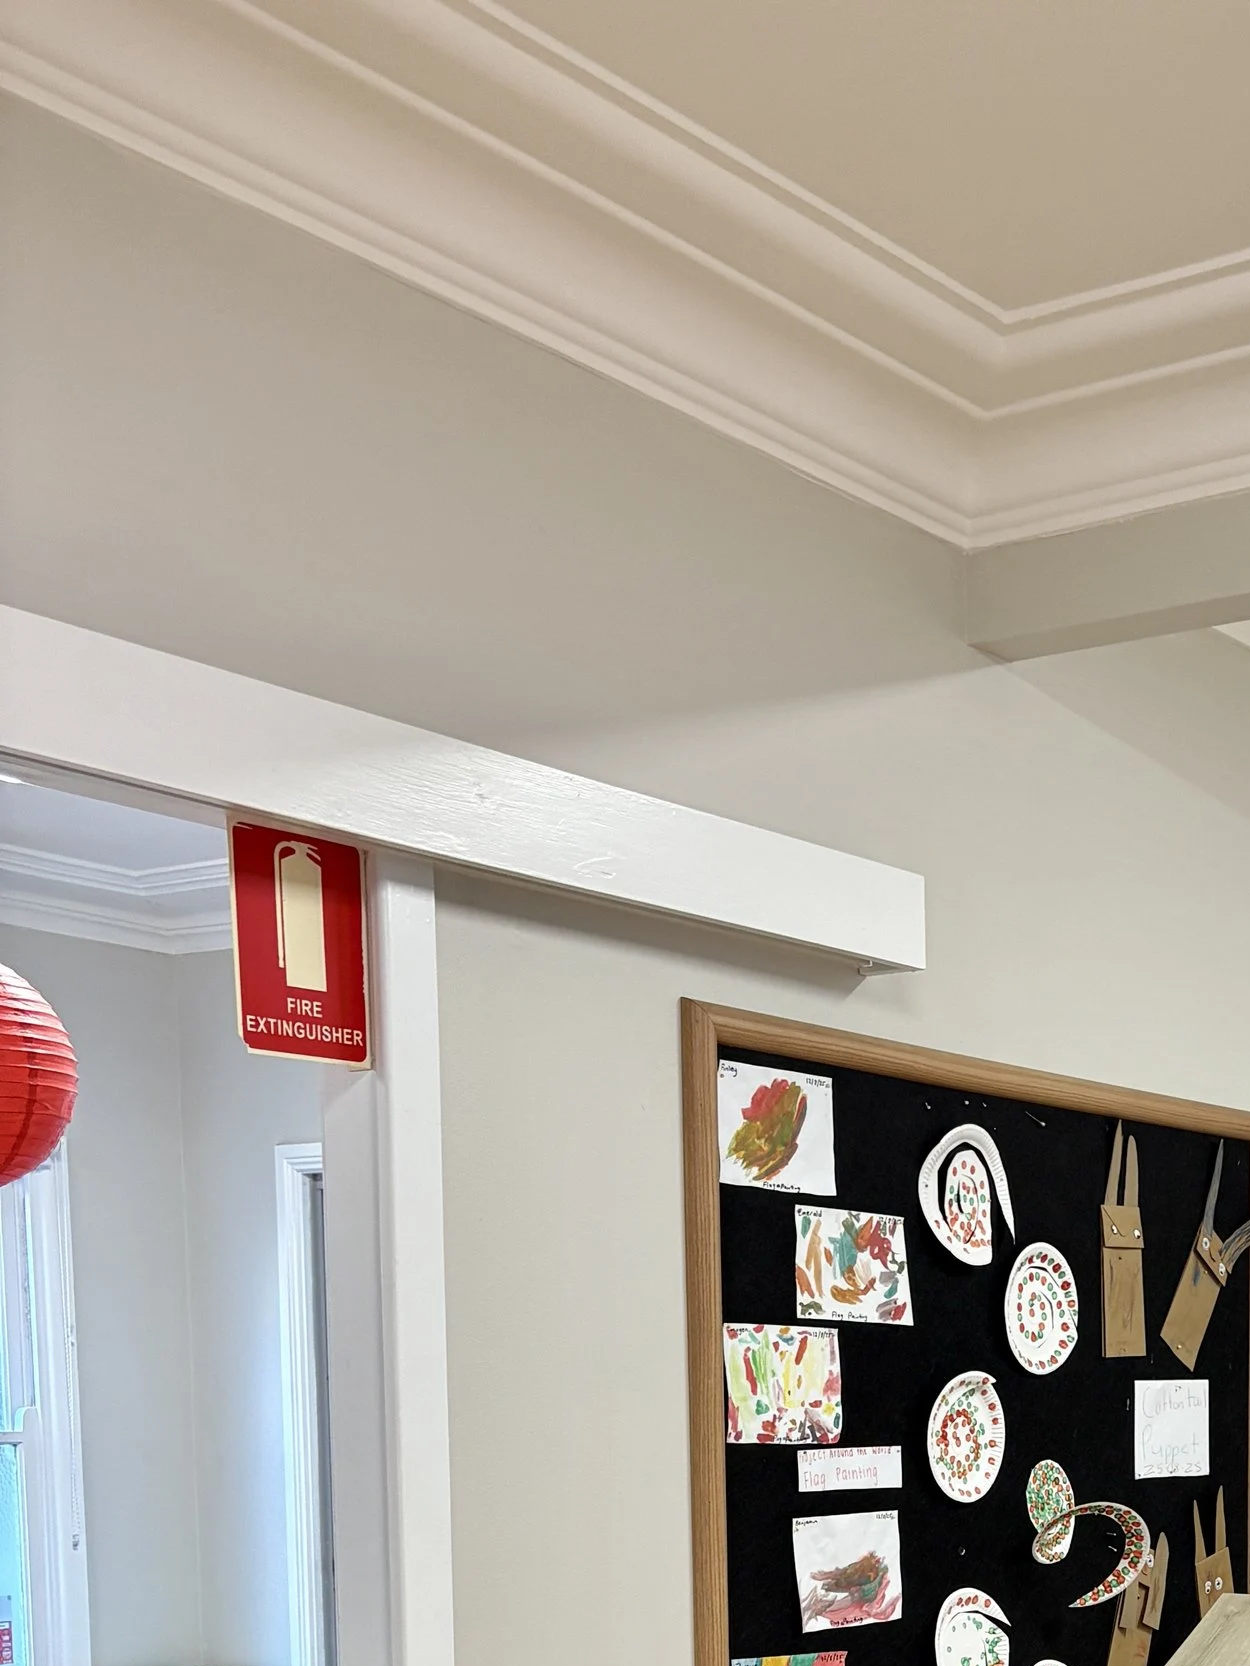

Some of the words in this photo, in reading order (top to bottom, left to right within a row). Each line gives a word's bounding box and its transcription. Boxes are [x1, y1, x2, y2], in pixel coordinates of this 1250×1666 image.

[286, 997, 323, 1018] FIRE
[246, 1014, 364, 1047] EXTINGUISHER
[831, 1310, 844, 1321] Flag
[829, 1448, 854, 1459] Around
[1142, 1423, 1199, 1470] Puppet
[803, 1470, 827, 1490] Flag
[835, 1466, 879, 1486] Painting
